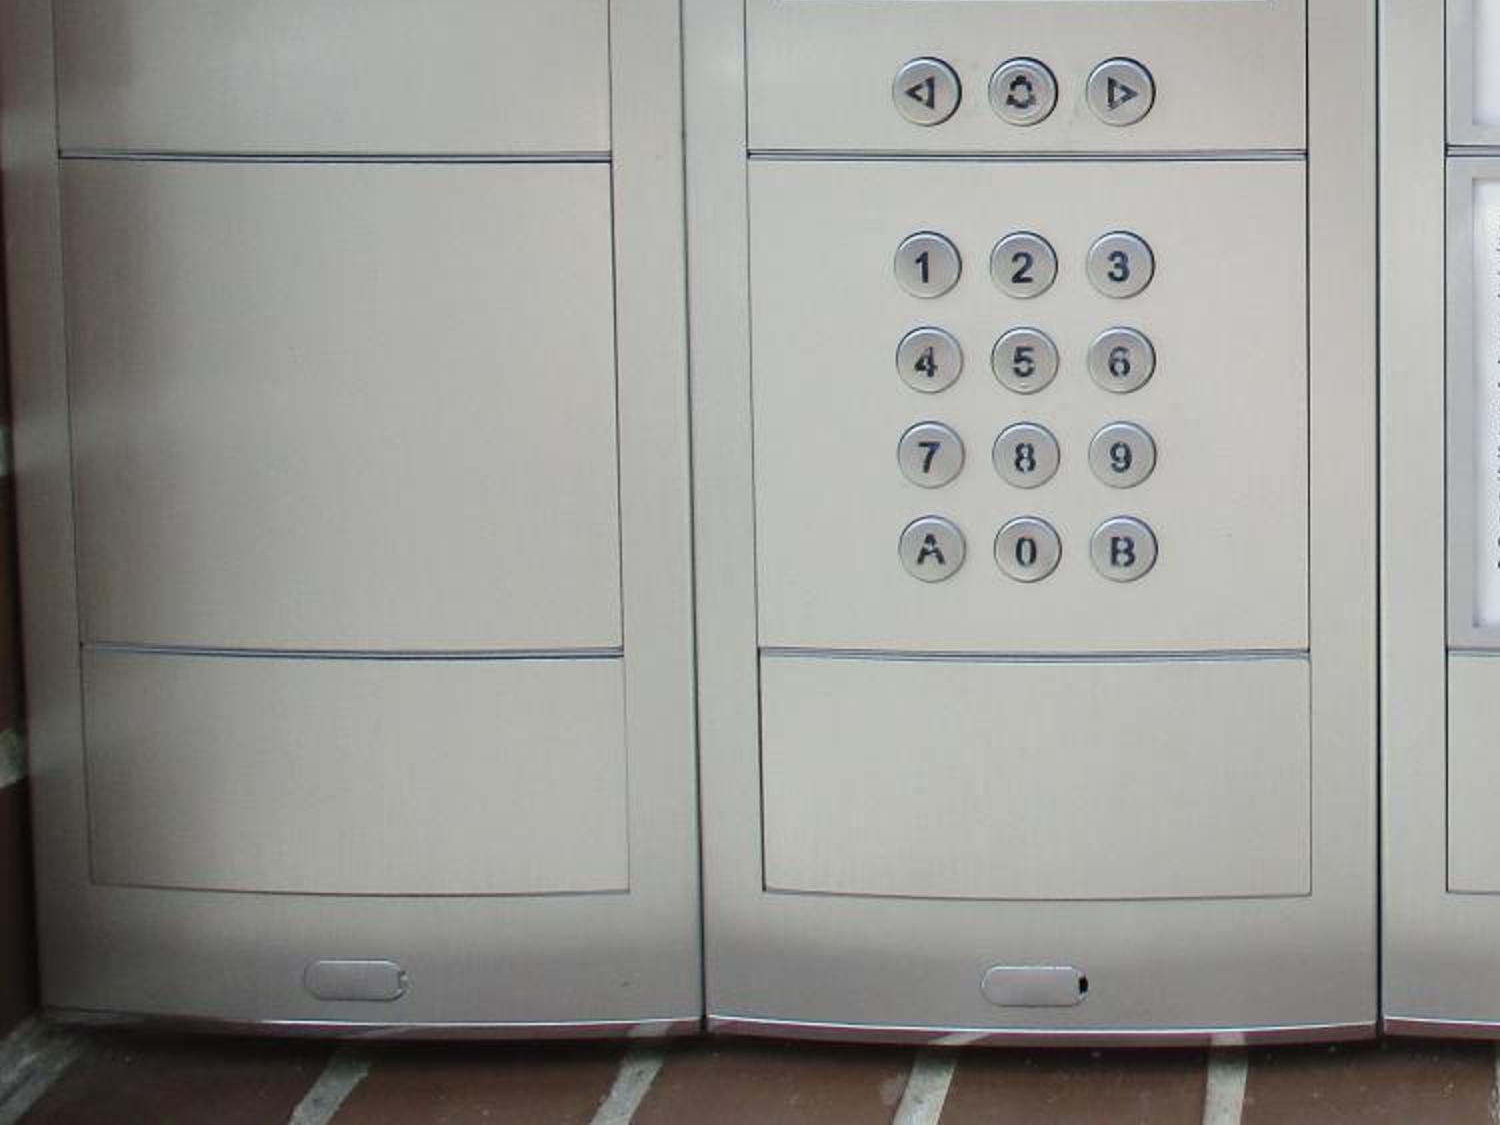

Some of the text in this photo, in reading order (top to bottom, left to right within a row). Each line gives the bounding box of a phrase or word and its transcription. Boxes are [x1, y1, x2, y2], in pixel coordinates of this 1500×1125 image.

[915, 251, 1130, 283] 1 2 3
[914, 347, 1131, 377] 4 5 6
[918, 442, 1132, 473] 7 8 9
[917, 534, 1135, 567] A 0 B
